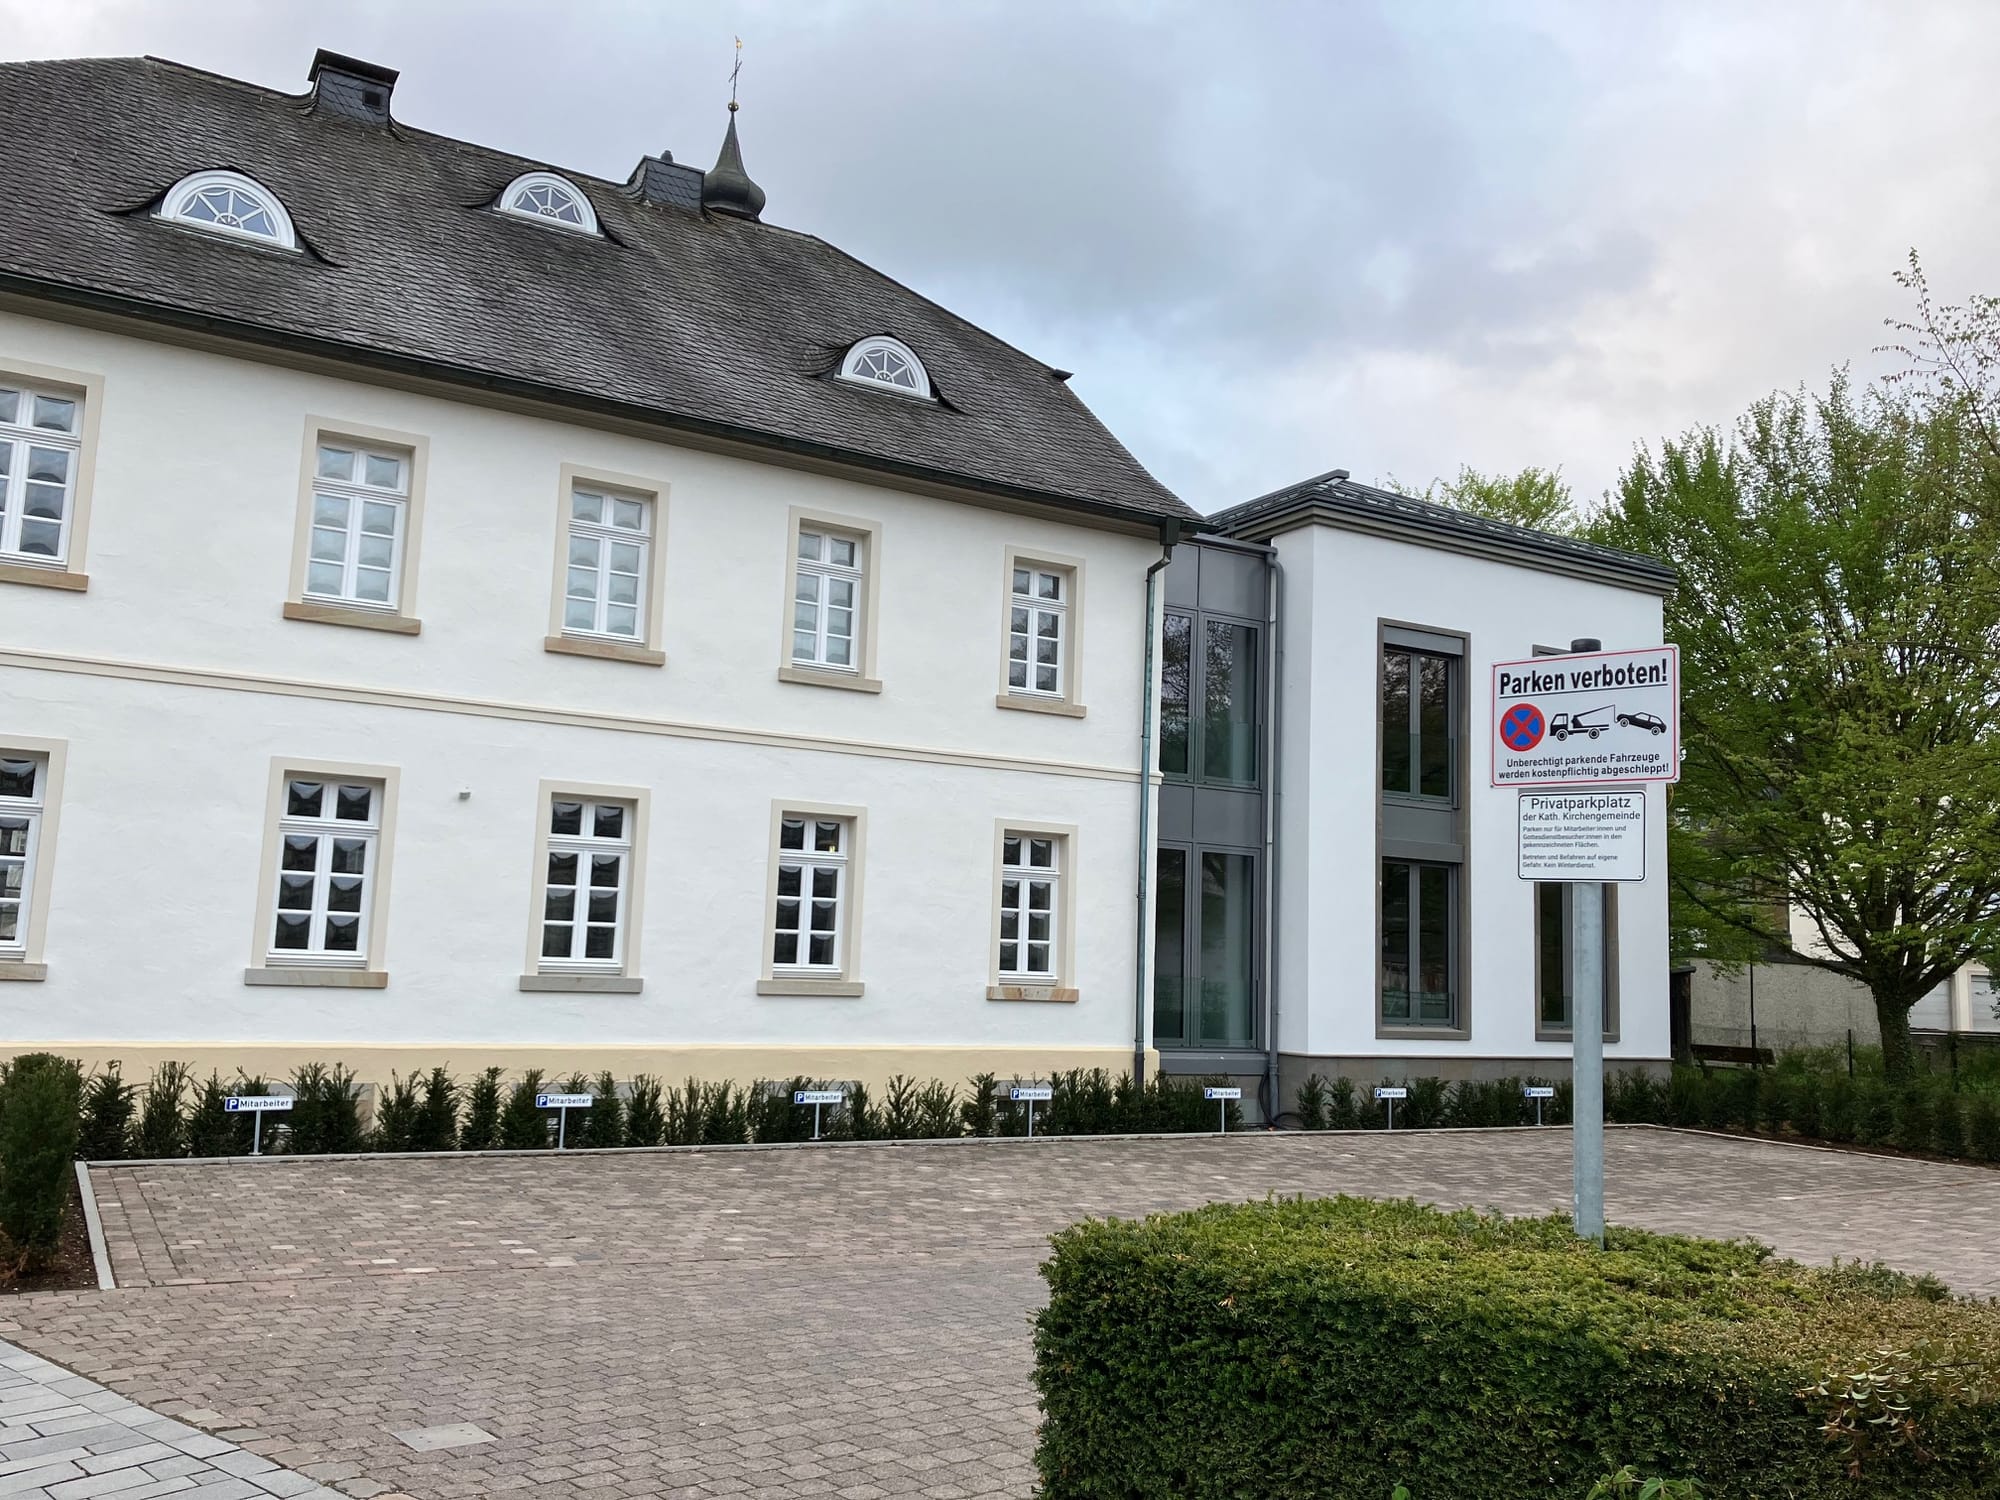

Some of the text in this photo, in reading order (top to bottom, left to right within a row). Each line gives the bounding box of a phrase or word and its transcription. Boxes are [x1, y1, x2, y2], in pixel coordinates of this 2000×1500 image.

[1499, 658, 1667, 695] Parken verboten!
[1506, 753, 1660, 768] Unberechtigt parkende Fahrzeuge
[1498, 763, 1669, 779] werden kostenpflichtig abgeschleppt!
[1531, 796, 1631, 811] Privatparkplatz
[1522, 811, 1640, 822] der Kath. Kirchengemeinde
[239, 1099, 290, 1108] Mitarbeiter
[548, 1096, 590, 1105] Mitarbeiter
